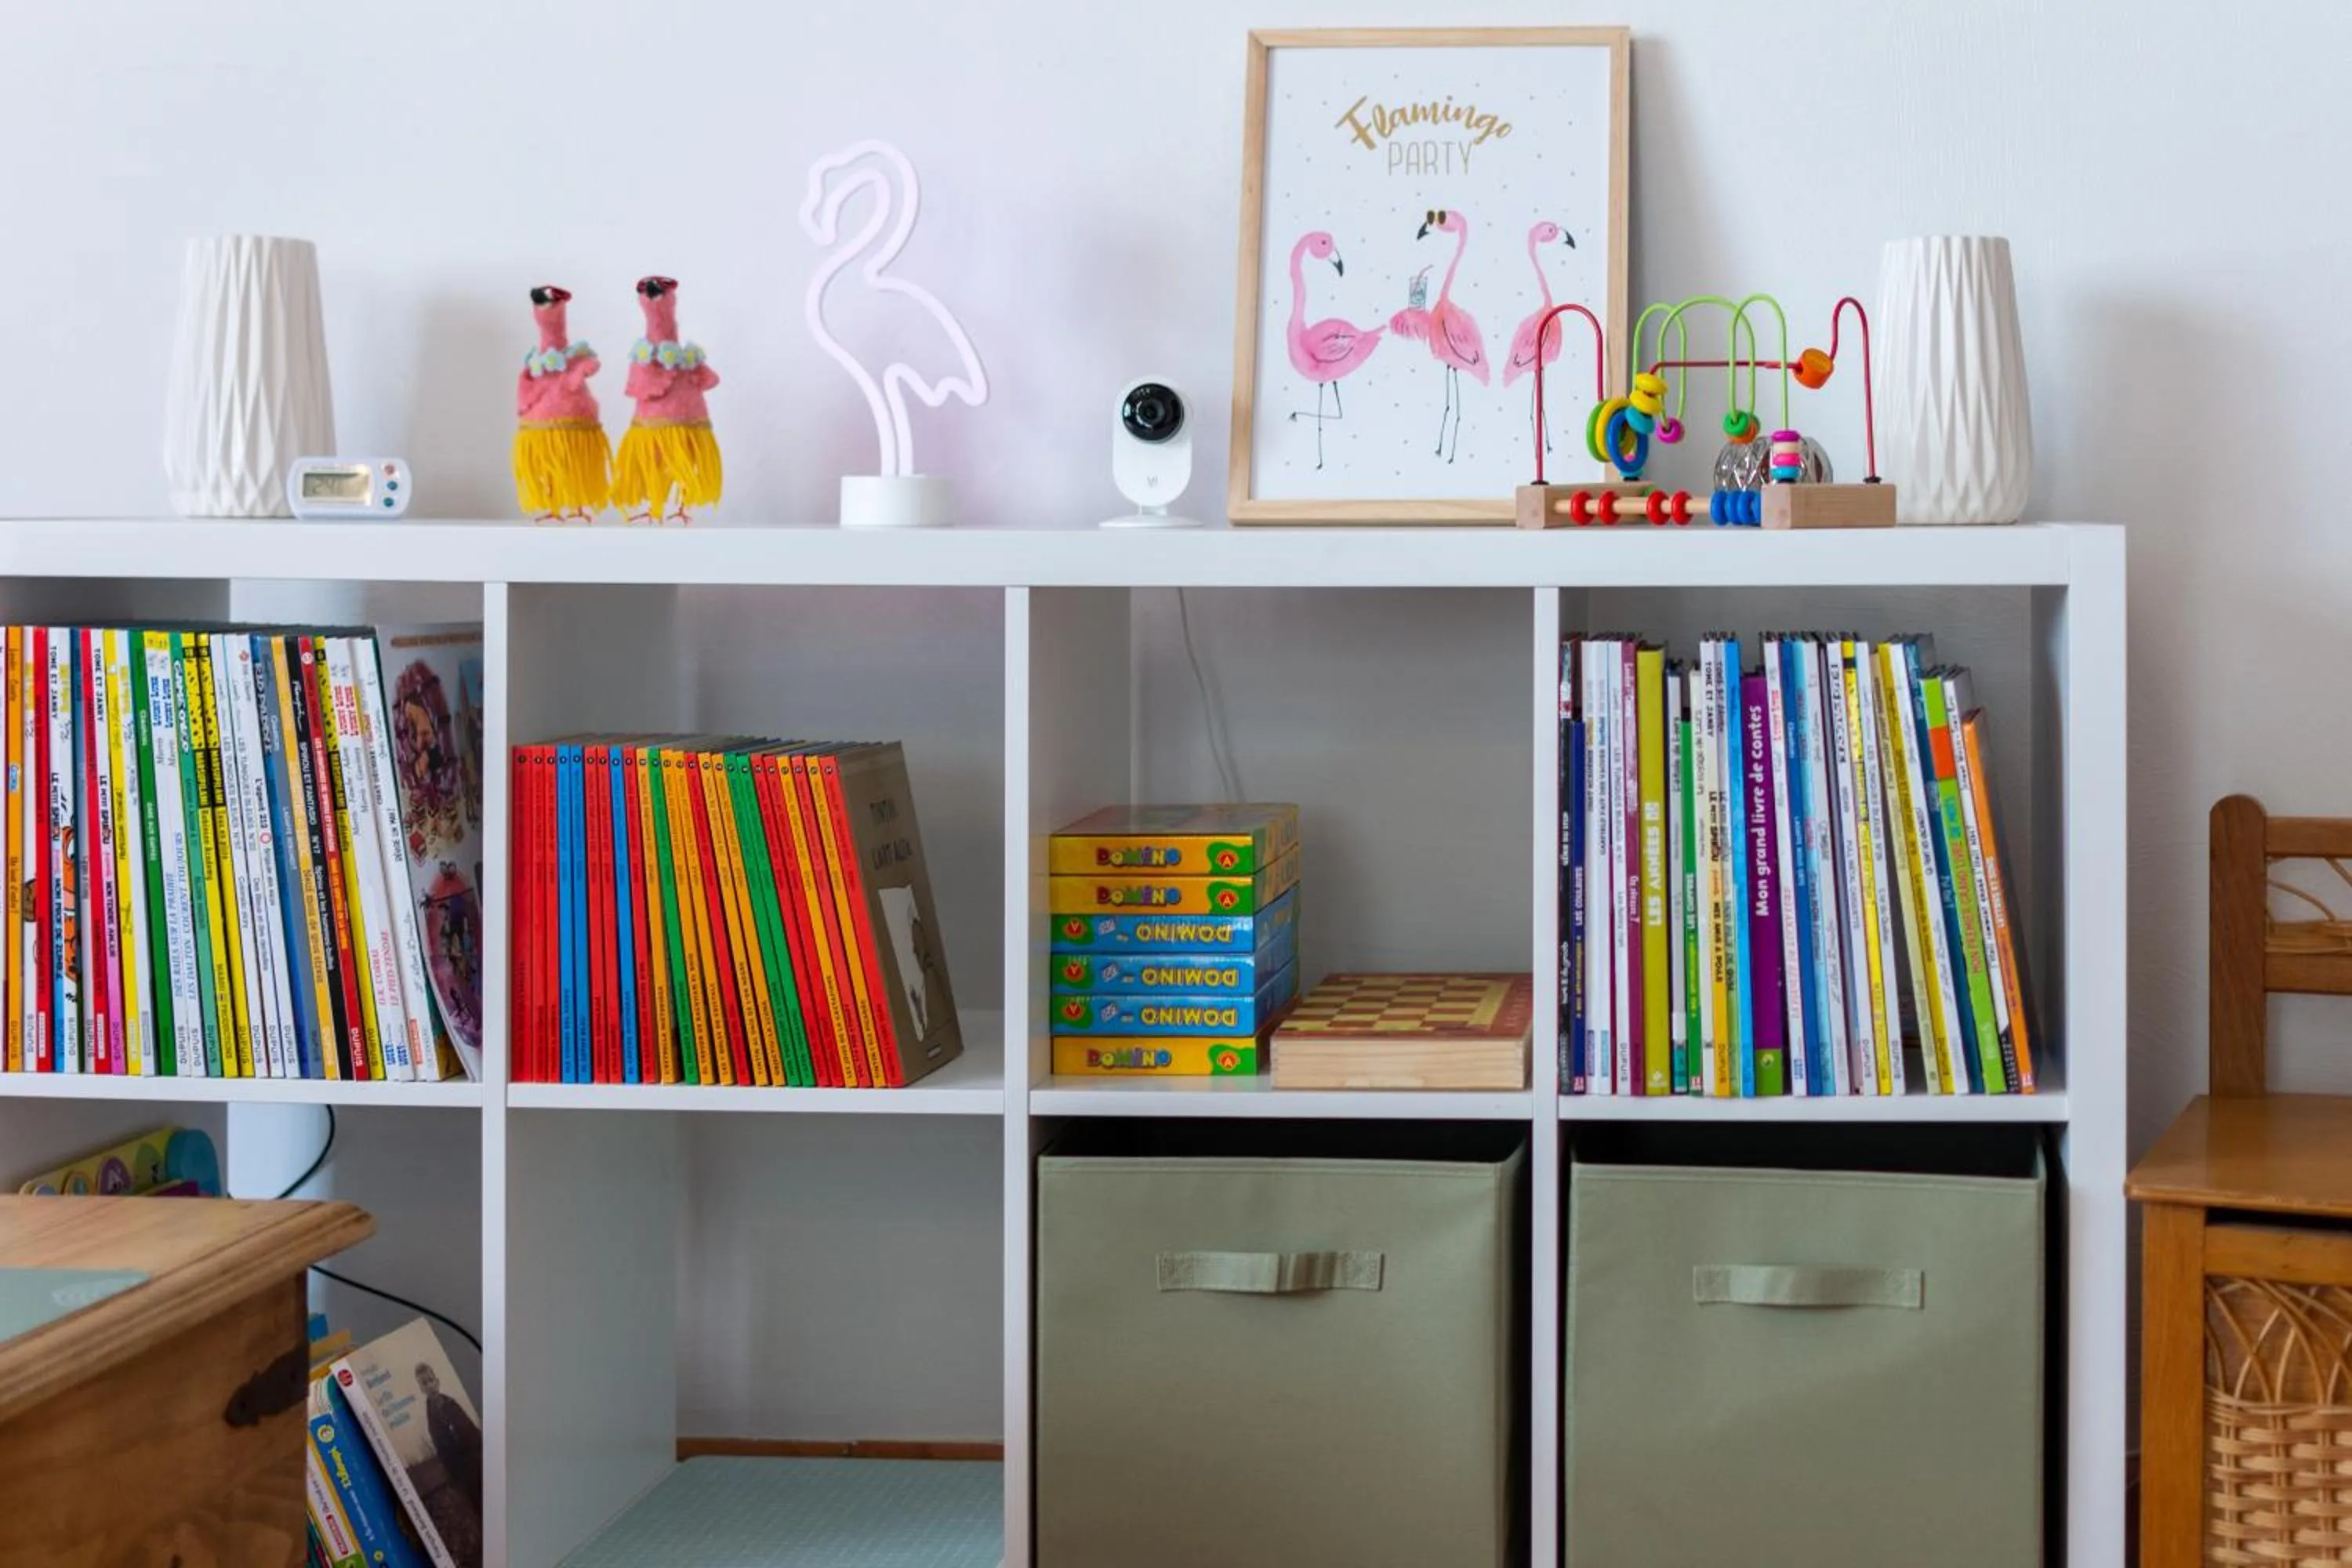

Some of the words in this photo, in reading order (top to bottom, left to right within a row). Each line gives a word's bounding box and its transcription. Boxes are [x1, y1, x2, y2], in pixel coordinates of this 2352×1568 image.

[1334, 95, 1513, 151] Flamingo
[1388, 141, 1472, 176] PARTY
[51, 673, 57, 684] ET
[96, 676, 102, 687] ET
[1706, 690, 1713, 702] ET
[1748, 706, 1762, 759] contes
[52, 772, 59, 783] LE
[100, 775, 107, 786] LE
[1749, 763, 1763, 782] de
[1709, 791, 1717, 803] LE
[1751, 786, 1765, 823] livre
[101, 809, 111, 844] SPIROU
[257, 815, 267, 829] 212
[1096, 847, 1181, 868] DOMINO
[1646, 826, 1661, 889] ANNÉES
[1710, 826, 1720, 862] SPIROU
[1751, 827, 1771, 876] grand
[1096, 886, 1181, 907] DOMINO
[1648, 895, 1662, 926] LES
[1713, 902, 1722, 919] MES
[1755, 879, 1769, 916] Mon
[1136, 924, 1232, 943] DOMINO
[1142, 968, 1239, 987] DOMINO
[1140, 1007, 1237, 1027] DOMINO
[192, 1029, 201, 1067] DUPUIS
[207, 1025, 216, 1064] DUPUIS
[238, 1026, 249, 1065] DUPUIS
[253, 1025, 262, 1064] DUPUIS
[269, 1025, 278, 1064] DUPUIS
[285, 1025, 295, 1064] DUPUIS
[351, 1027, 363, 1066] DUPUIS
[367, 1028, 378, 1067] DUPUIS
[1087, 1048, 1172, 1069] DOMINO
[1863, 1039, 1872, 1078] DUPUIS
[1892, 1040, 1901, 1079] DUPUIS
[1938, 1037, 1950, 1076] DUPUIS
[1718, 1044, 1726, 1083] DUPUIS
